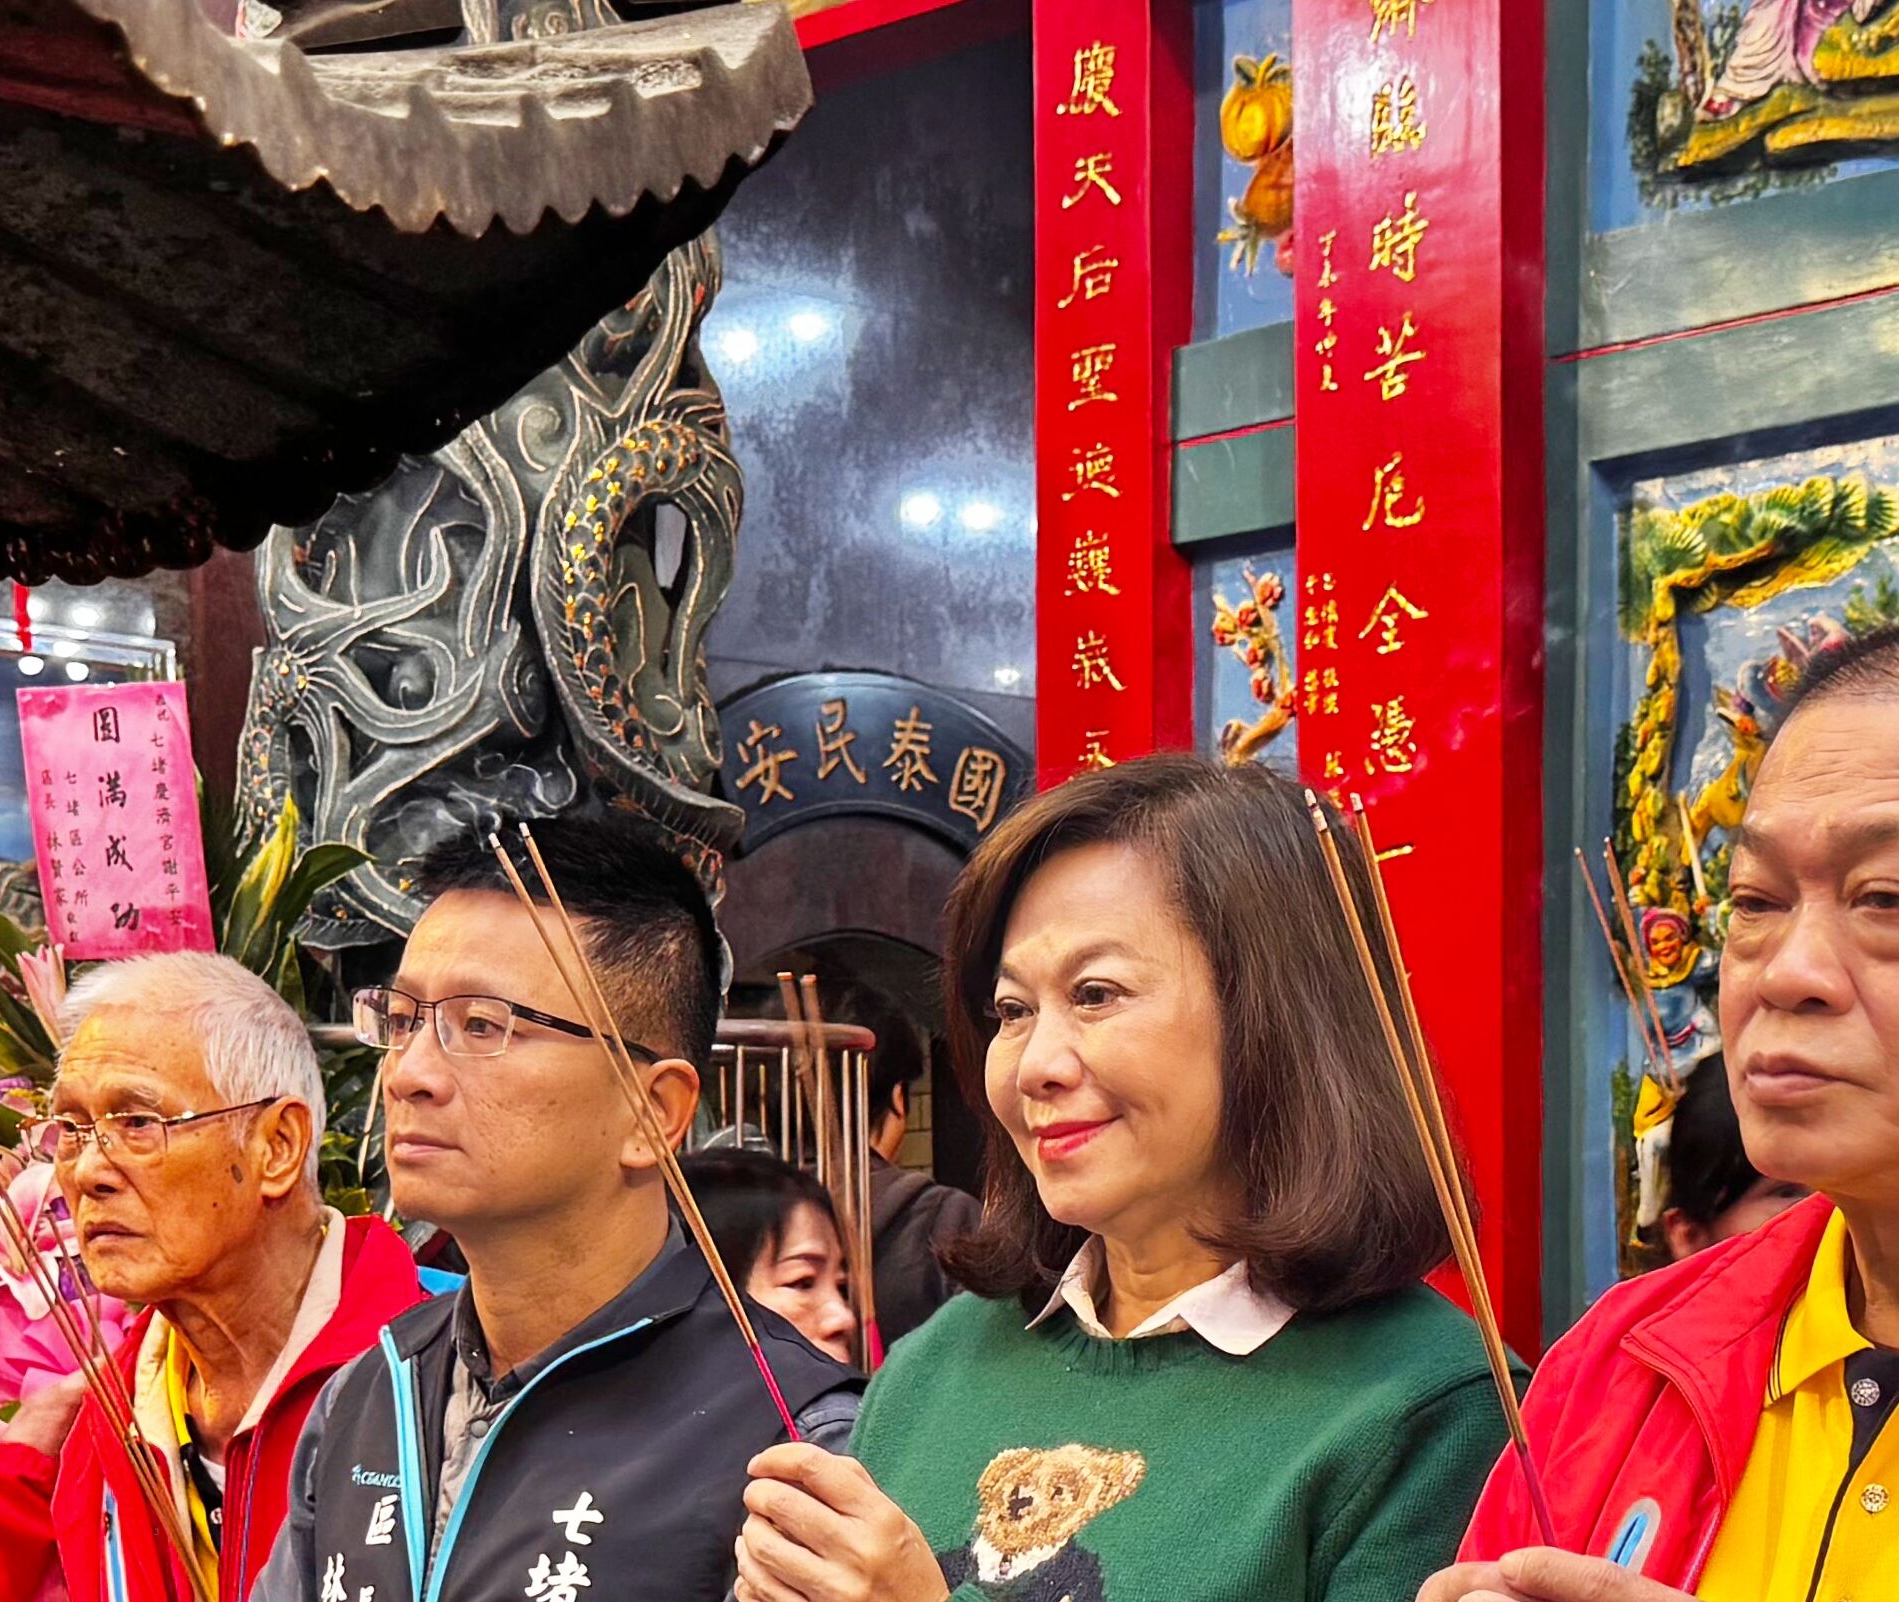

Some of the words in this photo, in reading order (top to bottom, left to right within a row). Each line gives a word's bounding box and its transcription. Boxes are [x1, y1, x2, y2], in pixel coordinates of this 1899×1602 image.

[93, 706, 140, 931] 圓滿成功
[735, 696, 1006, 834] 國泰民安
